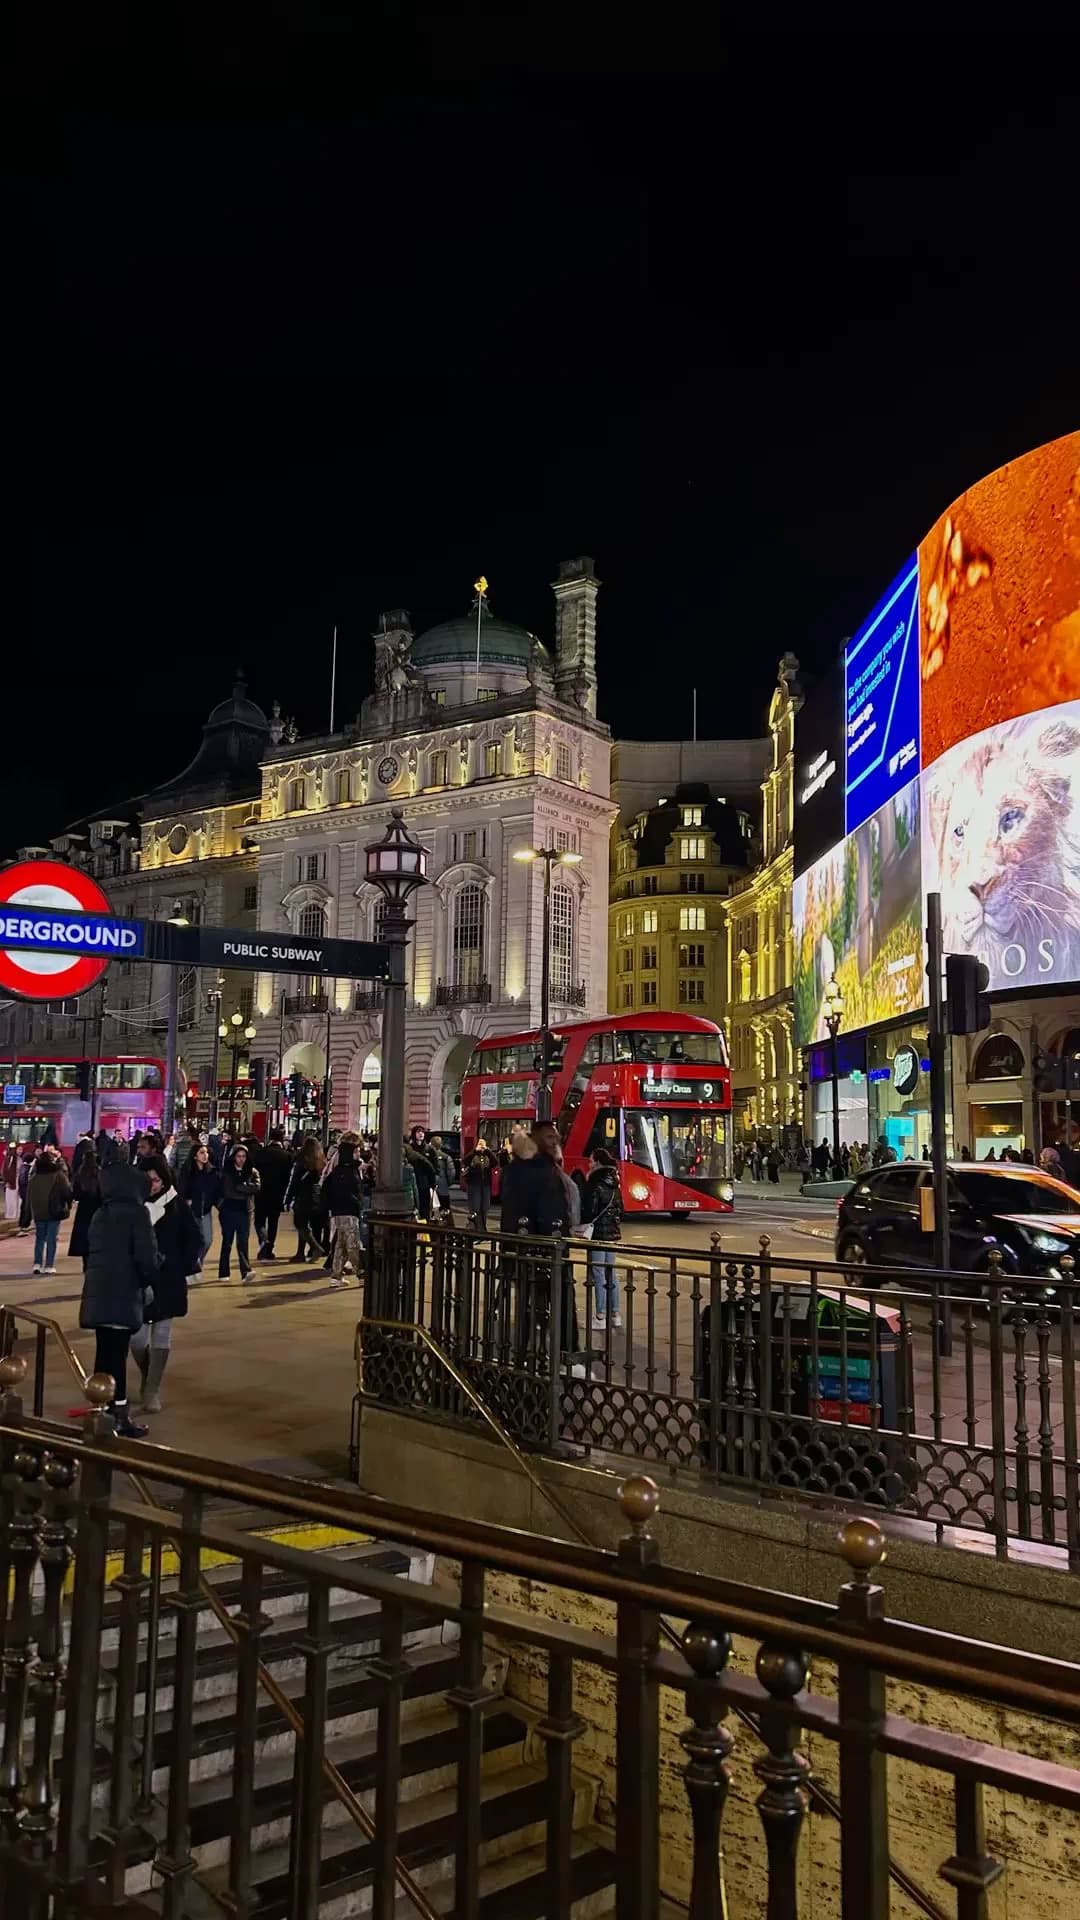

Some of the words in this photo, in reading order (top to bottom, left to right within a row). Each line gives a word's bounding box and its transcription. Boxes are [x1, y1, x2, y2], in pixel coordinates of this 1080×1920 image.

[223, 942, 269, 958] PUBLIC
[271, 946, 323, 962] SUBWAY
[703, 1082, 714, 1098] 9
